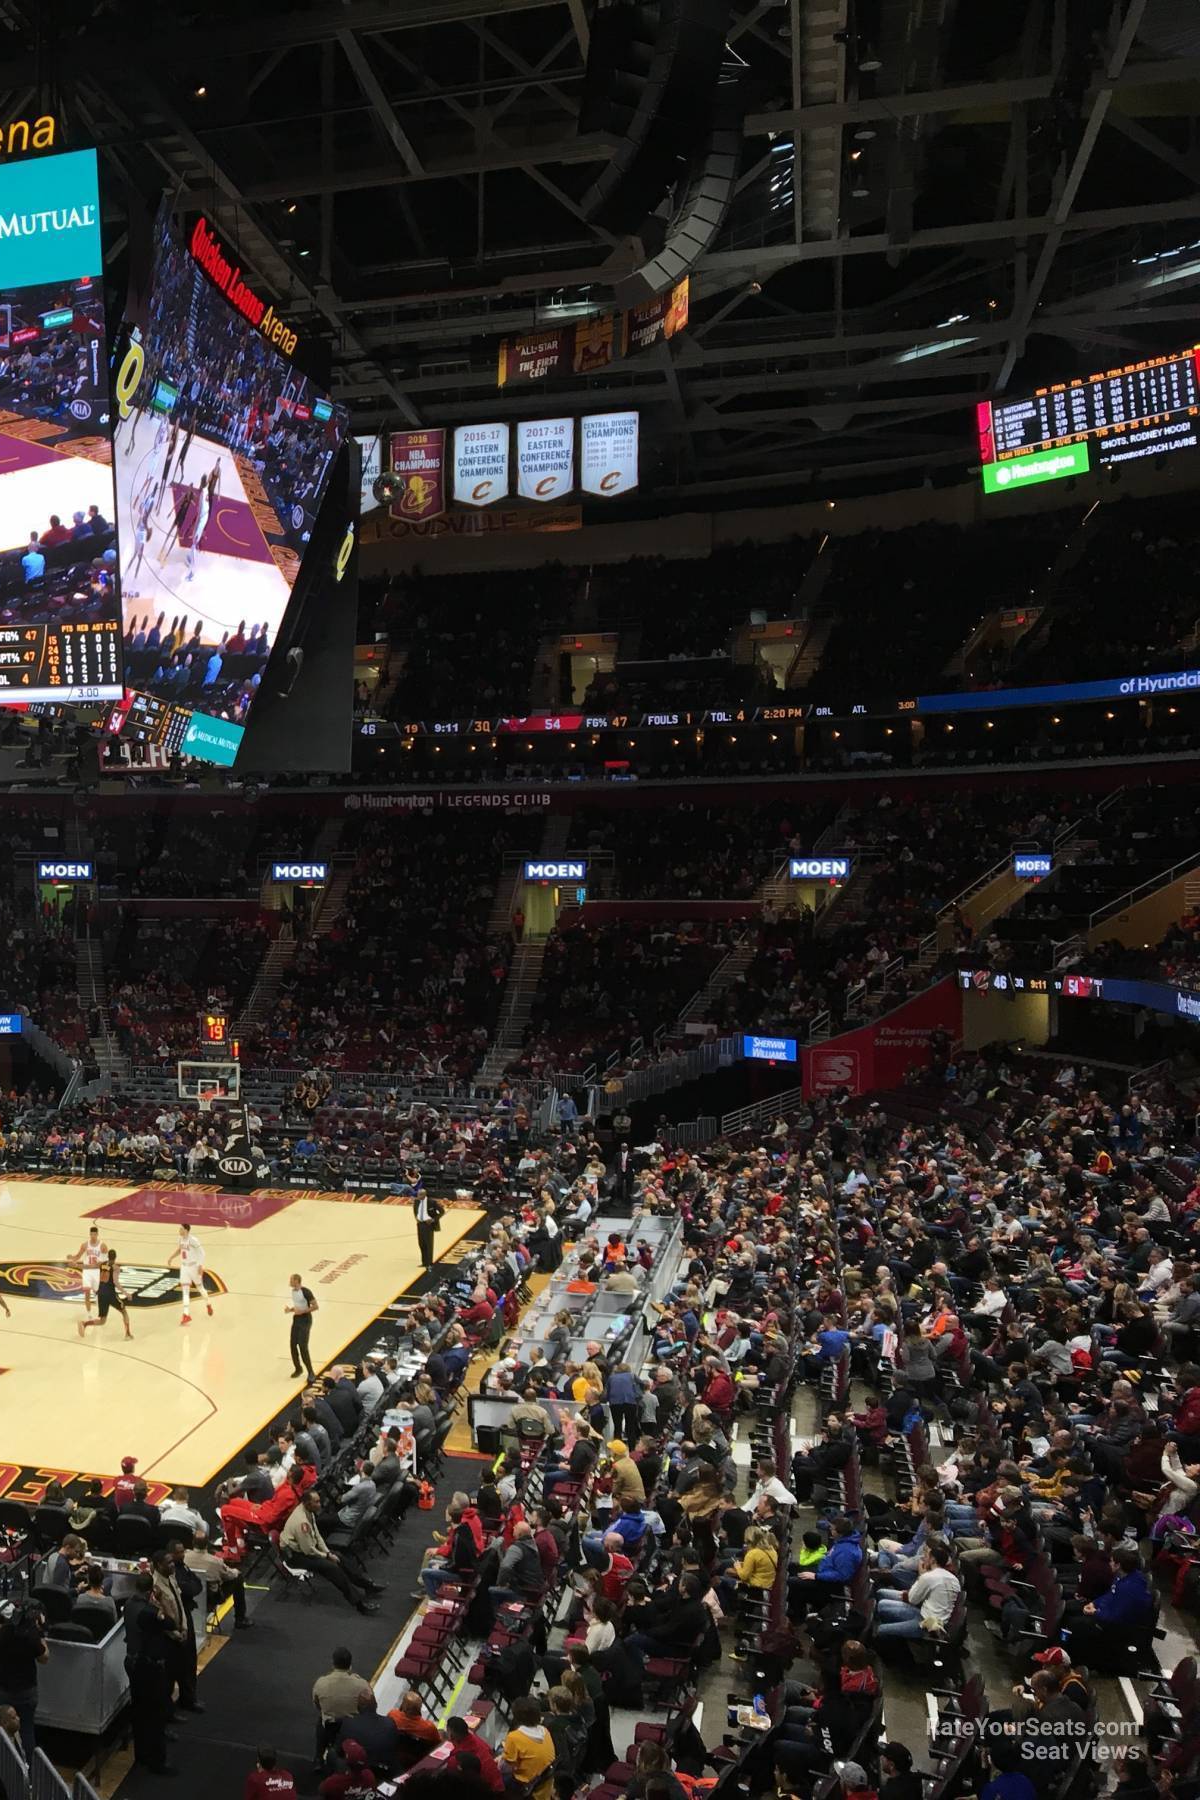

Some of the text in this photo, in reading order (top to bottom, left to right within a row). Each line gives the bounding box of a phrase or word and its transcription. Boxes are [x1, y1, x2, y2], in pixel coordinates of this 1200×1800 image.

[191, 217, 298, 356] Quicken Loans Arena
[519, 355, 559, 372] THE FIRST
[529, 366, 548, 379] CEDI
[584, 418, 637, 430] CENTRAL DIVISION
[464, 430, 501, 442] 2016-17
[526, 425, 565, 438] 2017-18
[586, 426, 634, 439] CHAMPIONS
[1130, 427, 1164, 443] RODNEY
[408, 434, 428, 445] 2016
[528, 439, 563, 450] EASTERN
[1169, 435, 1198, 450] LAVINE
[409, 449, 425, 460] NBA
[464, 444, 499, 455] EASTERN
[458, 454, 506, 467] CONFERENCE
[521, 450, 570, 462] CONFERENCE
[395, 458, 440, 471] CHAMPIONS
[522, 461, 568, 473] CHAMPIONS
[460, 465, 504, 478] CHAMPIONS
[92, 623, 103, 631] AST
[0, 630, 37, 642] FG% 47
[48, 636, 57, 645] 15
[23, 651, 35, 661] 47
[48, 646, 59, 655] 24
[48, 655, 59, 664] 42
[65, 665, 73, 674] 14
[22, 673, 29, 684] 4
[50, 675, 60, 684] 32
[1120, 678, 1135, 694] of
[763, 708, 802, 719] 2:20 PM
[816, 705, 833, 716] ORL
[852, 704, 867, 714] ATL
[586, 716, 627, 728] FG% 47
[648, 714, 678, 725] FOULS
[711, 710, 744, 722] TOL: 4
[361, 723, 376, 735] 46
[404, 723, 418, 734] 19
[434, 723, 459, 733] 9:11
[474, 721, 490, 732] 3Q
[545, 718, 560, 730] 54
[40, 863, 90, 878] MOEN
[275, 865, 325, 878] MOEN
[528, 863, 583, 878] MOEN
[792, 861, 846, 875] MOEN
[1015, 861, 1050, 872] MOEN
[994, 974, 1007, 990] 46
[1030, 978, 1047, 990] 9:11
[1069, 979, 1079, 994] 54
[210, 1026, 223, 1040] 19
[752, 1037, 786, 1049] SHERWIN
[224, 1161, 247, 1172] KIA
